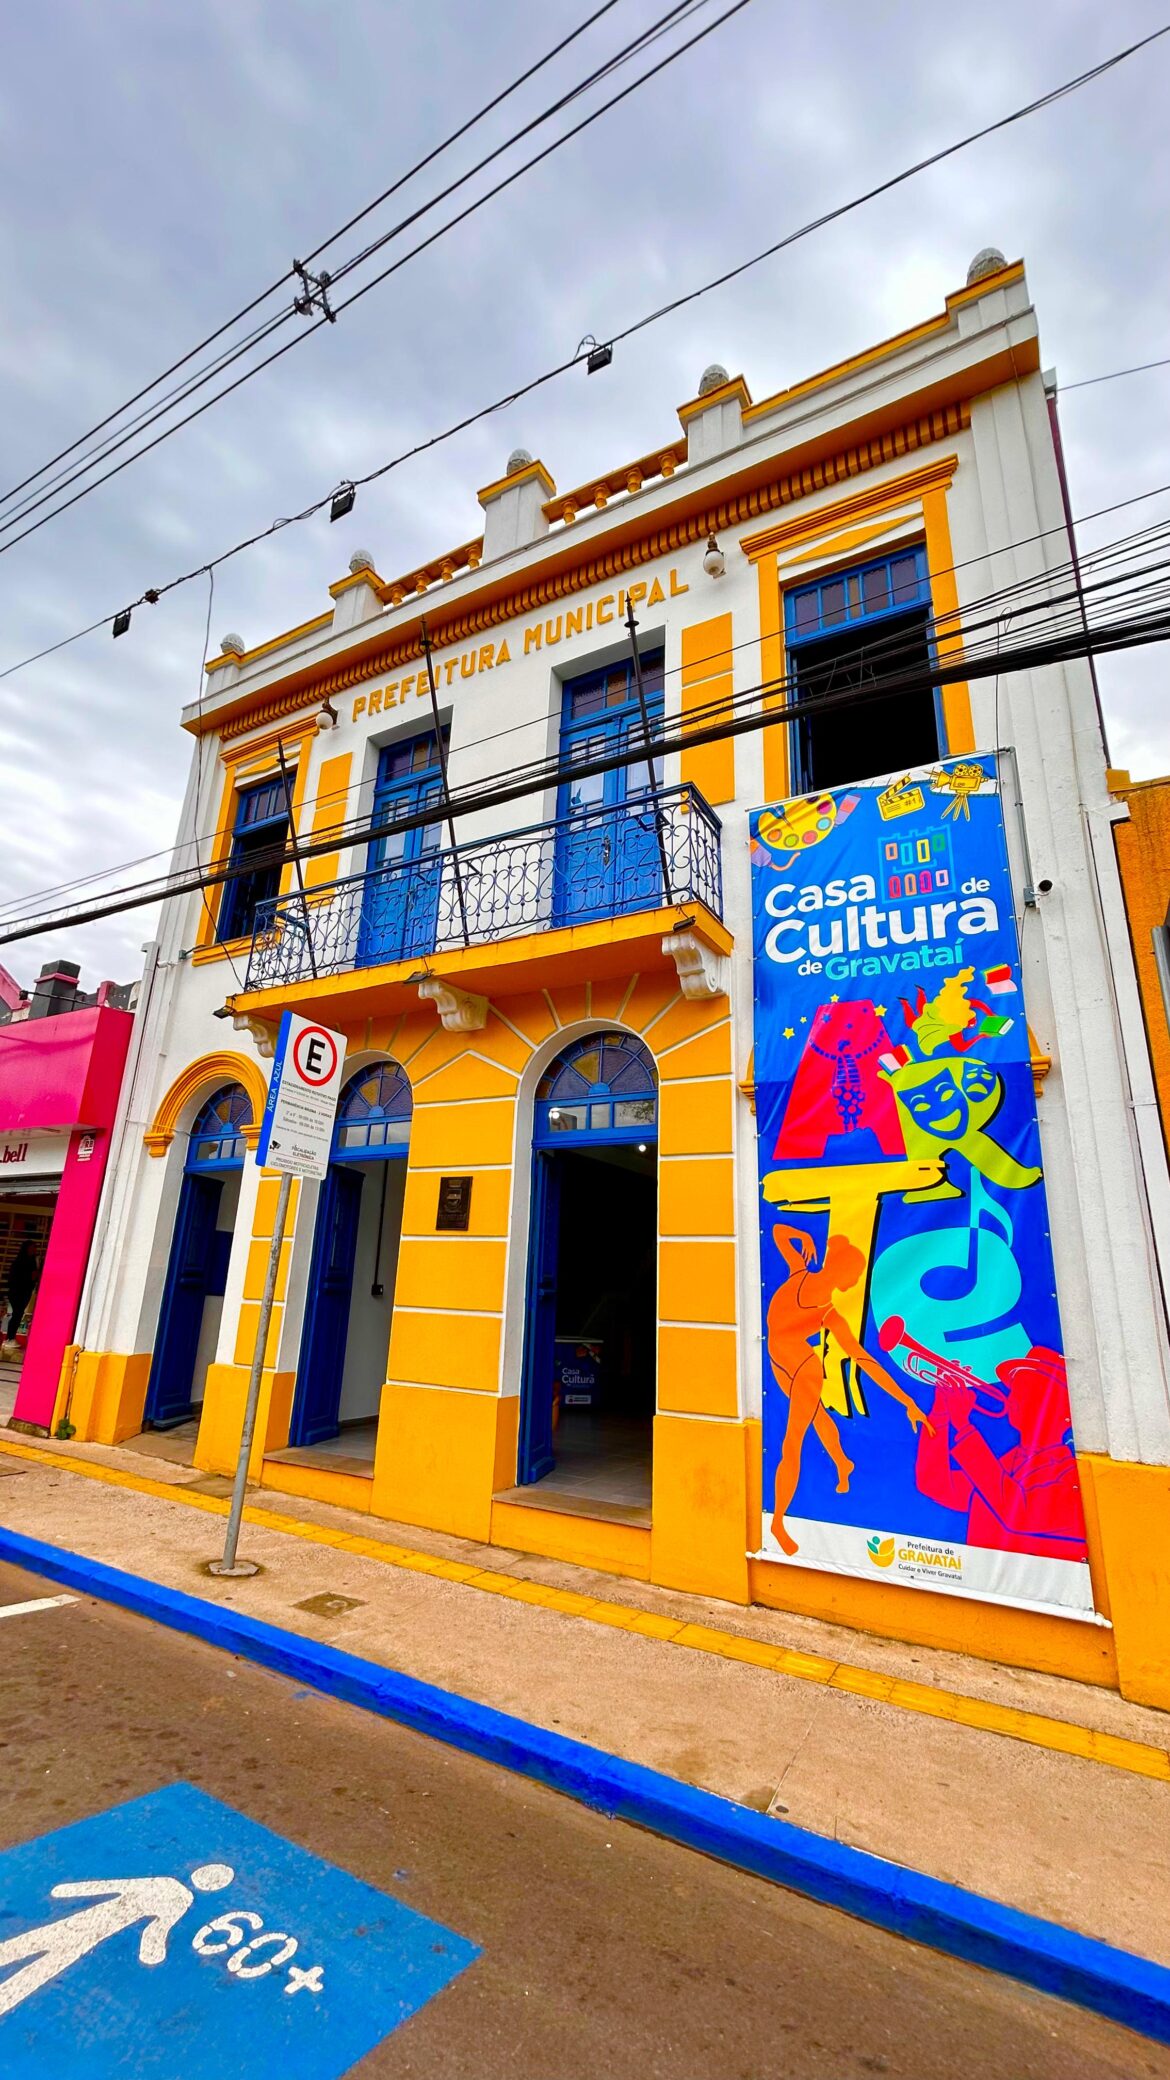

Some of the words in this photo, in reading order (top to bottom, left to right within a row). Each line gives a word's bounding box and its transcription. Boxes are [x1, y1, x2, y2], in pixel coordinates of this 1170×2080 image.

[352, 638, 511, 723] PREFEITURA
[524, 567, 690, 655] MUNICIPAL
[764, 874, 876, 918] Casa
[961, 877, 991, 895] de
[765, 896, 1000, 963] Cultura
[797, 959, 823, 976] de
[825, 938, 963, 981] Gravataí
[306, 1037, 326, 1075] E
[266, 1087, 278, 1113] ÁREA
[273, 1060, 283, 1083] AZUL
[561, 1375, 595, 1384] Cultura
[562, 1367, 580, 1375] Casa
[898, 1548, 962, 1570] GRAVATAÍ
[907, 1541, 942, 1553] Prefeitura
[944, 1547, 955, 1556] de
[898, 1563, 916, 1572] Cuidar
[922, 1567, 937, 1576] Viver
[192, 1911, 325, 1995] 60+
